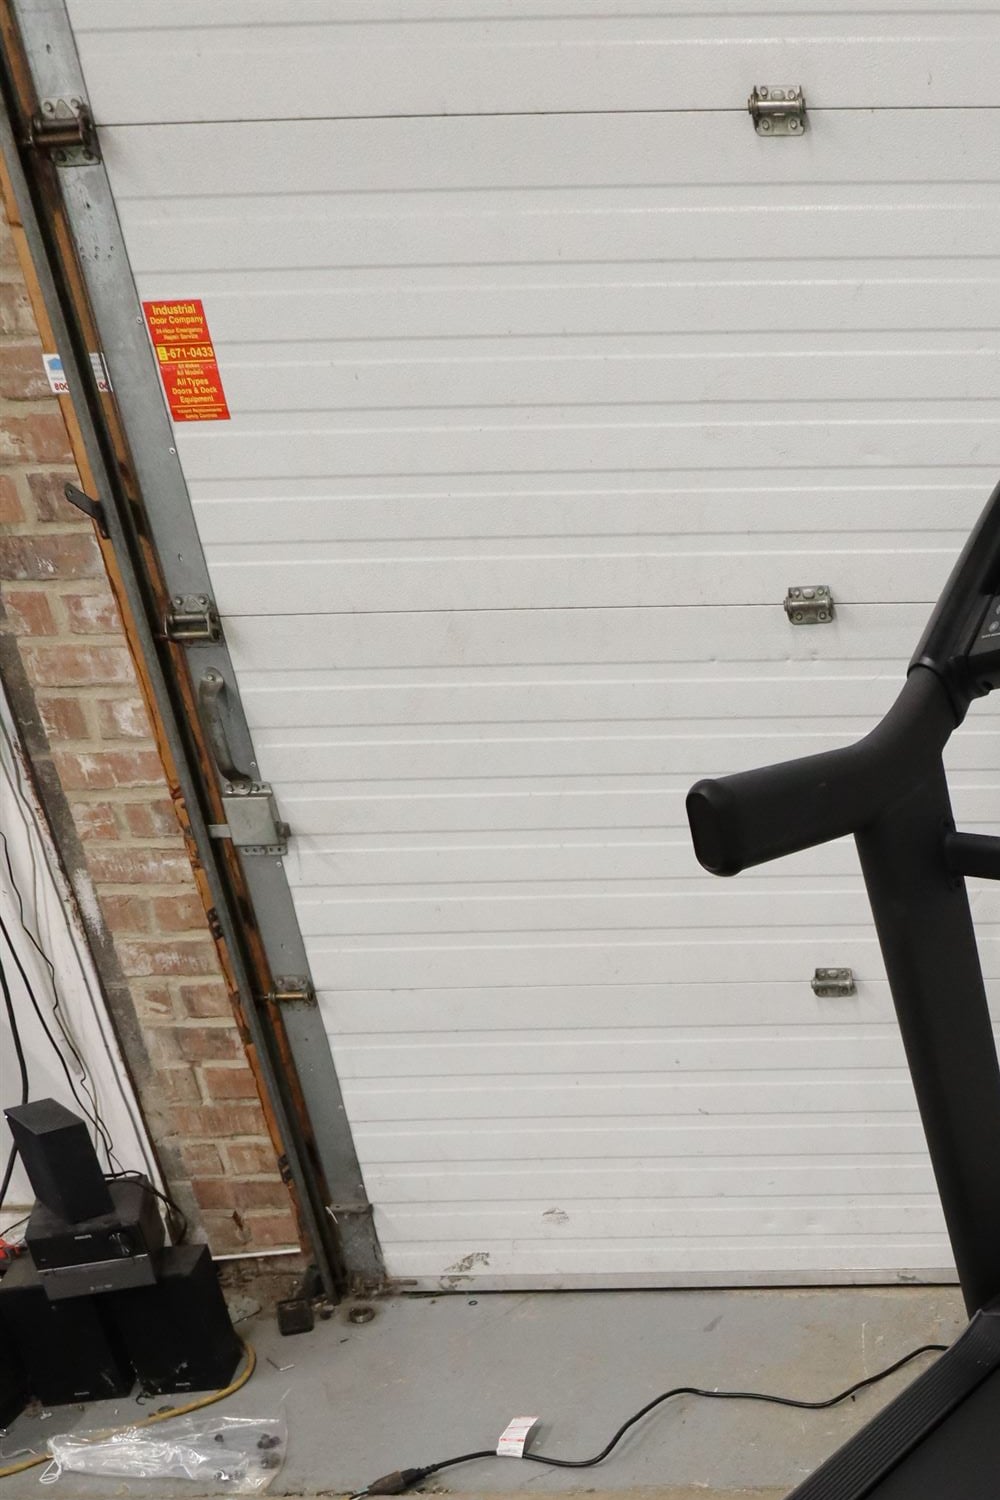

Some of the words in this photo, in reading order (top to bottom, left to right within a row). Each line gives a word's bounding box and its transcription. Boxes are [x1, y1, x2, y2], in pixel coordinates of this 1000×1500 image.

[152, 304, 196, 315] Industrial
[150, 316, 168, 325] Door
[169, 315, 203, 325] Company
[177, 378, 187, 386] All
[187, 377, 209, 387] Types
[172, 387, 193, 395] Doors
[200, 386, 218, 394] Dock
[180, 395, 215, 404] Equipment
